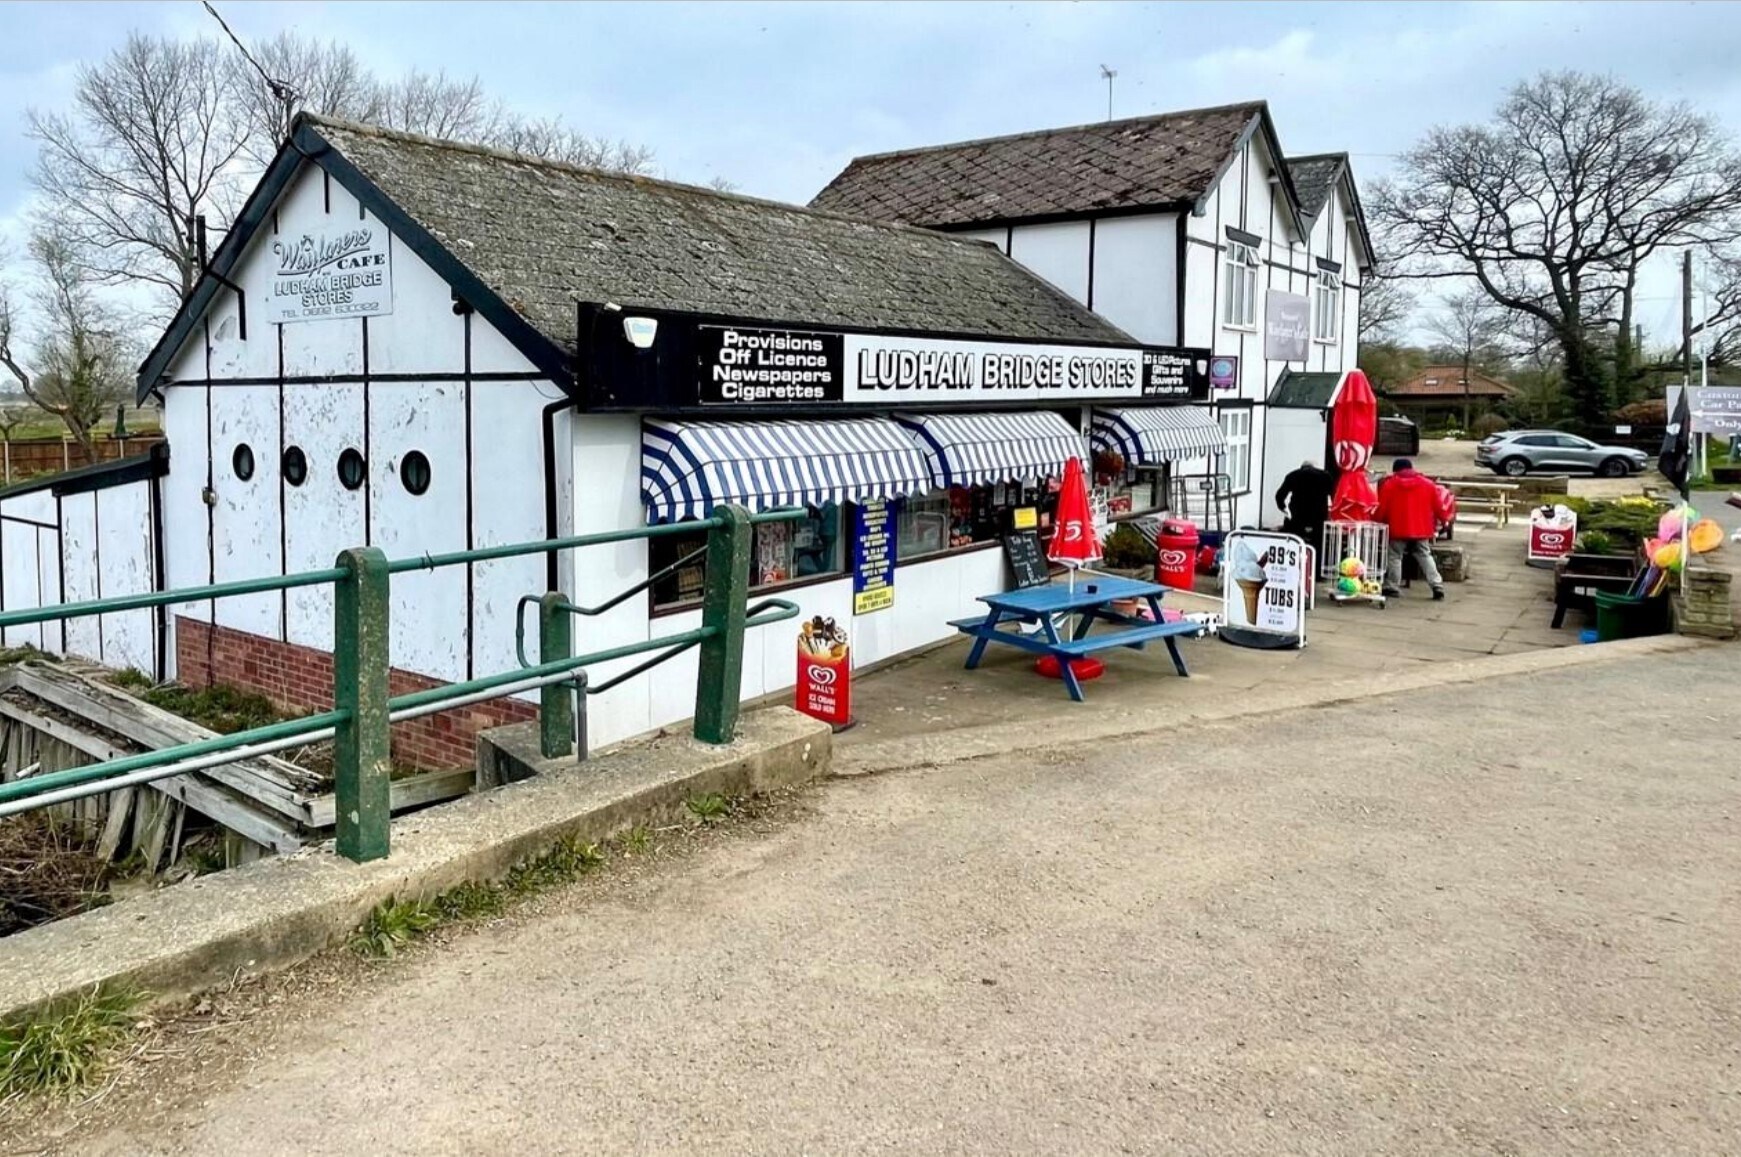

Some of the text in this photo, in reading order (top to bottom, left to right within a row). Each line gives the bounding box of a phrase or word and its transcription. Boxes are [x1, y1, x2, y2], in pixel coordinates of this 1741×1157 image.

[337, 253, 386, 270] CAFE
[274, 271, 382, 298] LUDHAM BRIDGE
[301, 291, 353, 308] STORES
[723, 331, 823, 351] Provisions
[719, 348, 828, 367] Off Licence
[713, 365, 832, 384] Newspapers
[858, 348, 1137, 390] LUDHAM BRIDGE STORES
[1171, 365, 1184, 375] and
[1151, 375, 1184, 385] Souvenirs
[721, 382, 825, 401] Cigarettes
[1701, 400, 1725, 408] Car
[1265, 587, 1294, 608] TUBS
